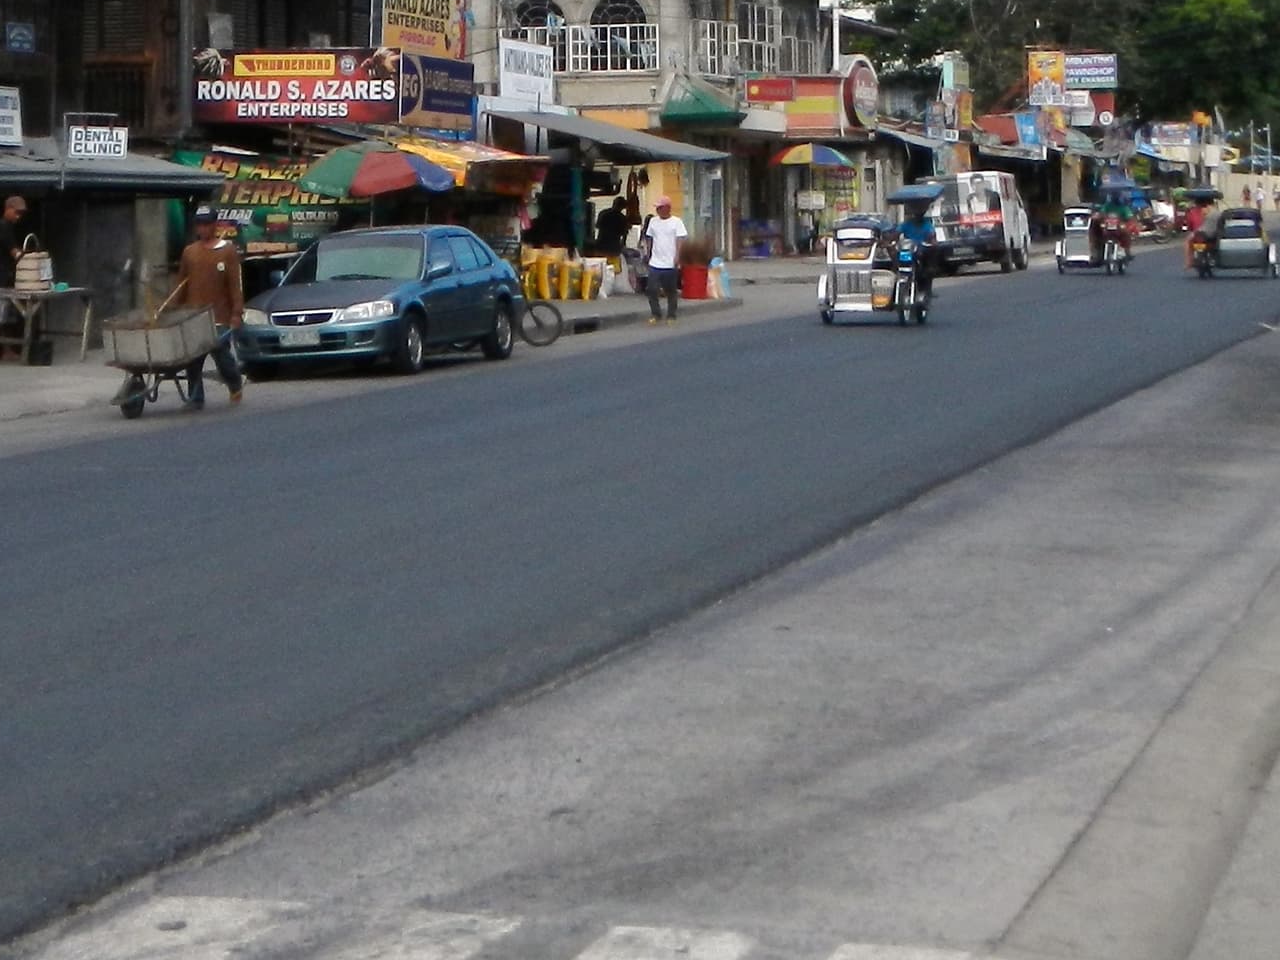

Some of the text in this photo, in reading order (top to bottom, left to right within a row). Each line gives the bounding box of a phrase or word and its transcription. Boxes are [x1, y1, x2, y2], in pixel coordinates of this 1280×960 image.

[387, 11, 446, 35] ENTERPRISES
[256, 59, 332, 71] THUNDERBIRD
[197, 79, 396, 101] RONALD S. AZARES
[237, 102, 349, 117] ENTERPRISES
[74, 130, 122, 142] DENTAL
[73, 142, 122, 155] CLINIC
